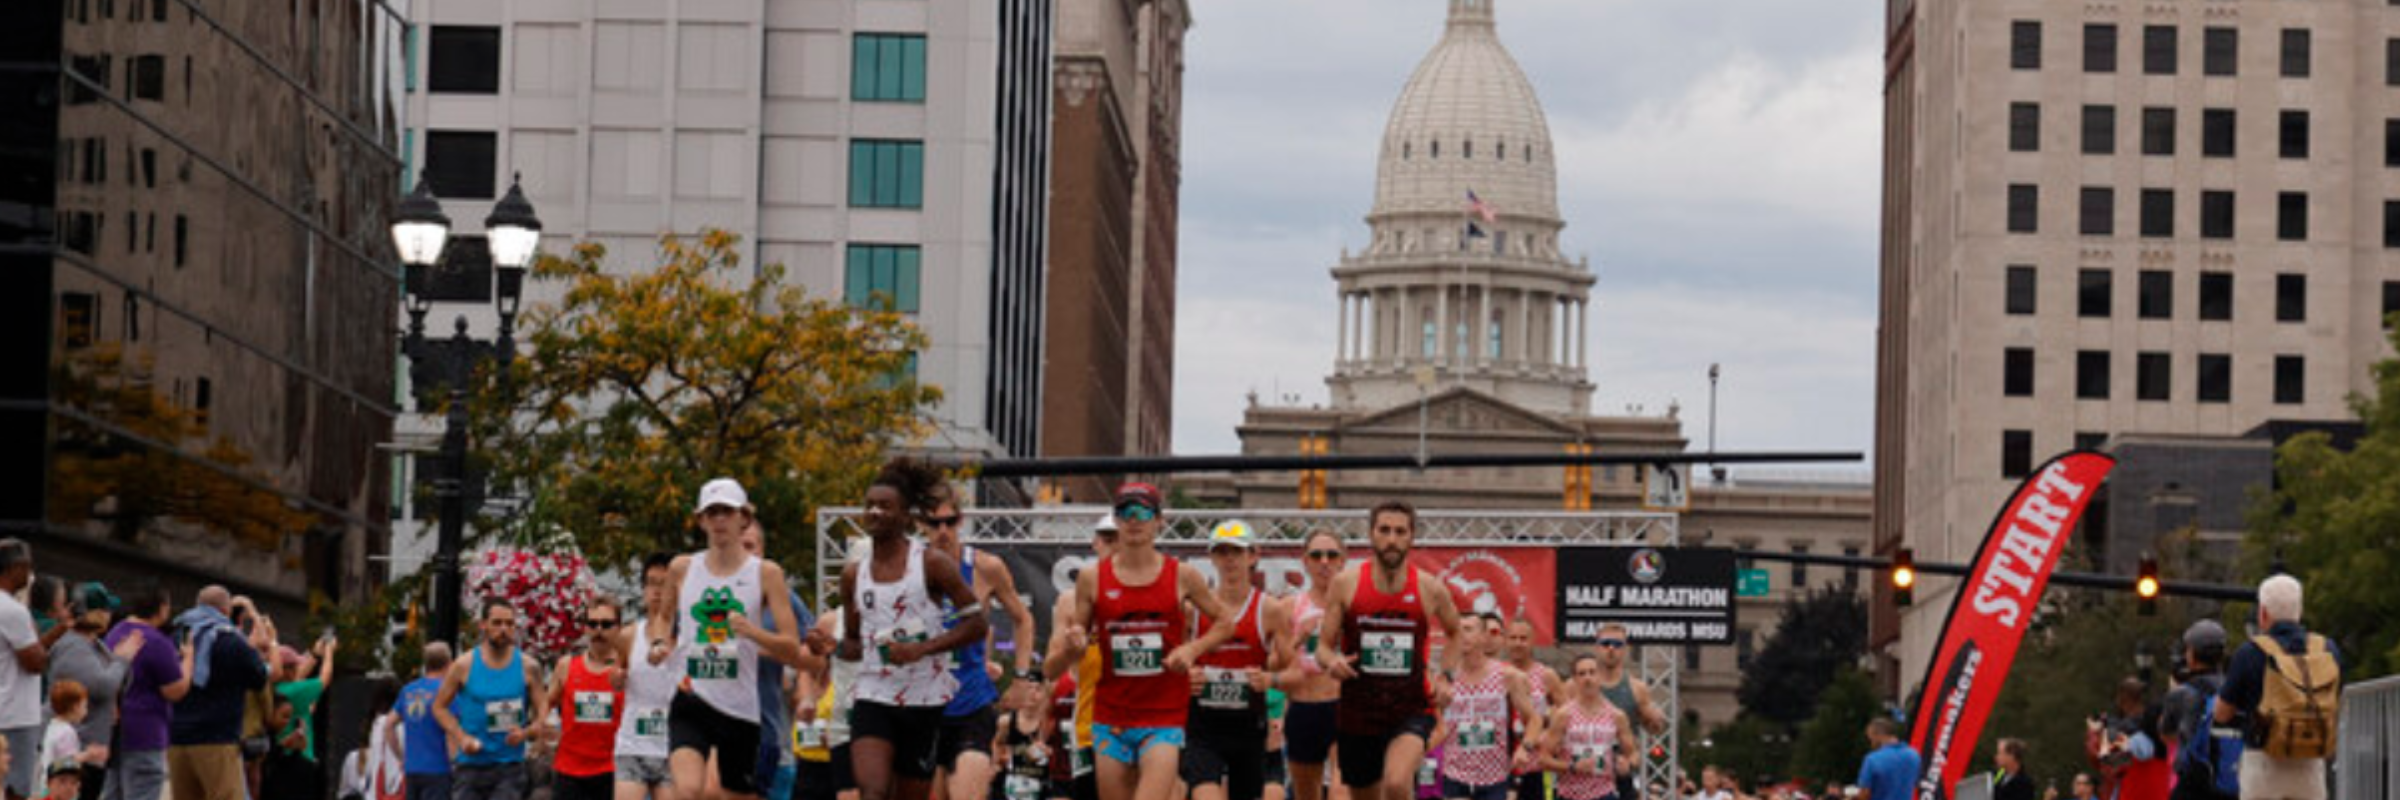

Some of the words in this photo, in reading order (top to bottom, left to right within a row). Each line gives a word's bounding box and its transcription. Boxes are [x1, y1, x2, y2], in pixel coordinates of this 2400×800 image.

[1973, 461, 2084, 627] START
[1566, 587, 1615, 606] HALF
[1621, 588, 1727, 607] MARATHON
[1692, 622, 1727, 639] MSU
